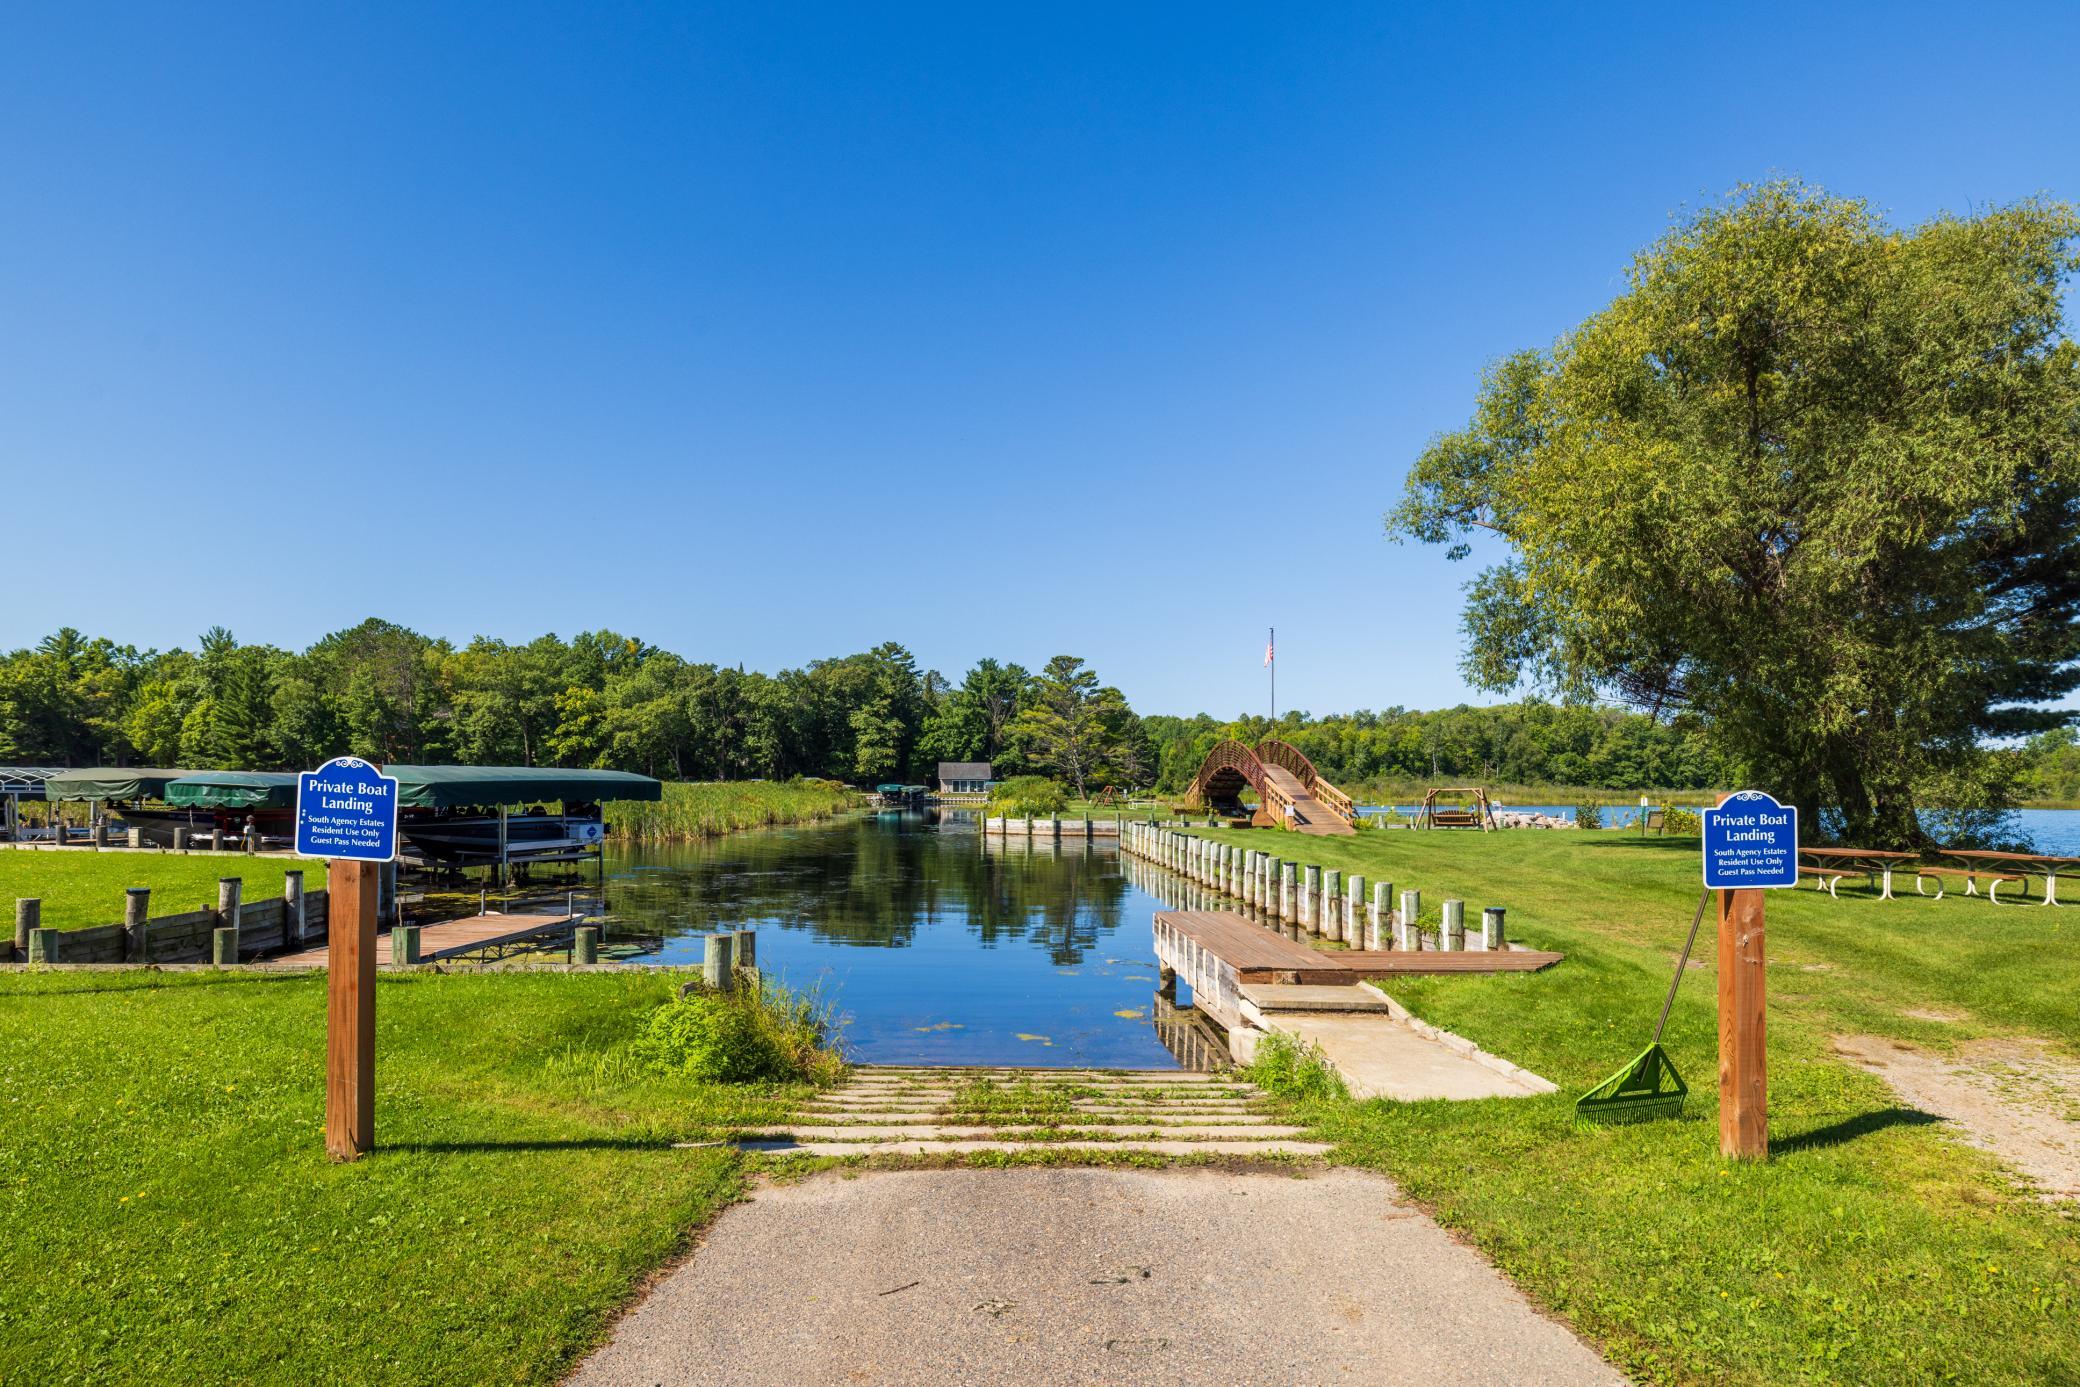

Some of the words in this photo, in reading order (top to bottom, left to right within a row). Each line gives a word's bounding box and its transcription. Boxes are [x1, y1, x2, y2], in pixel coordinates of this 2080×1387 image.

[310, 780, 353, 793] Private
[358, 782, 388, 796] Boat
[322, 796, 373, 814] Landing
[308, 815, 329, 823] South
[331, 817, 357, 827] Agency
[360, 818, 384, 827] Estates
[1713, 814, 1755, 826] Private
[1760, 814, 1788, 825] Boat
[312, 826, 343, 834] Resident
[362, 829, 380, 838] Only
[1726, 829, 1775, 844] Landing
[311, 836, 332, 844] Guest
[352, 839, 380, 847] Needed
[1736, 849, 1761, 857] Agency
[1766, 857, 1783, 866] Only
